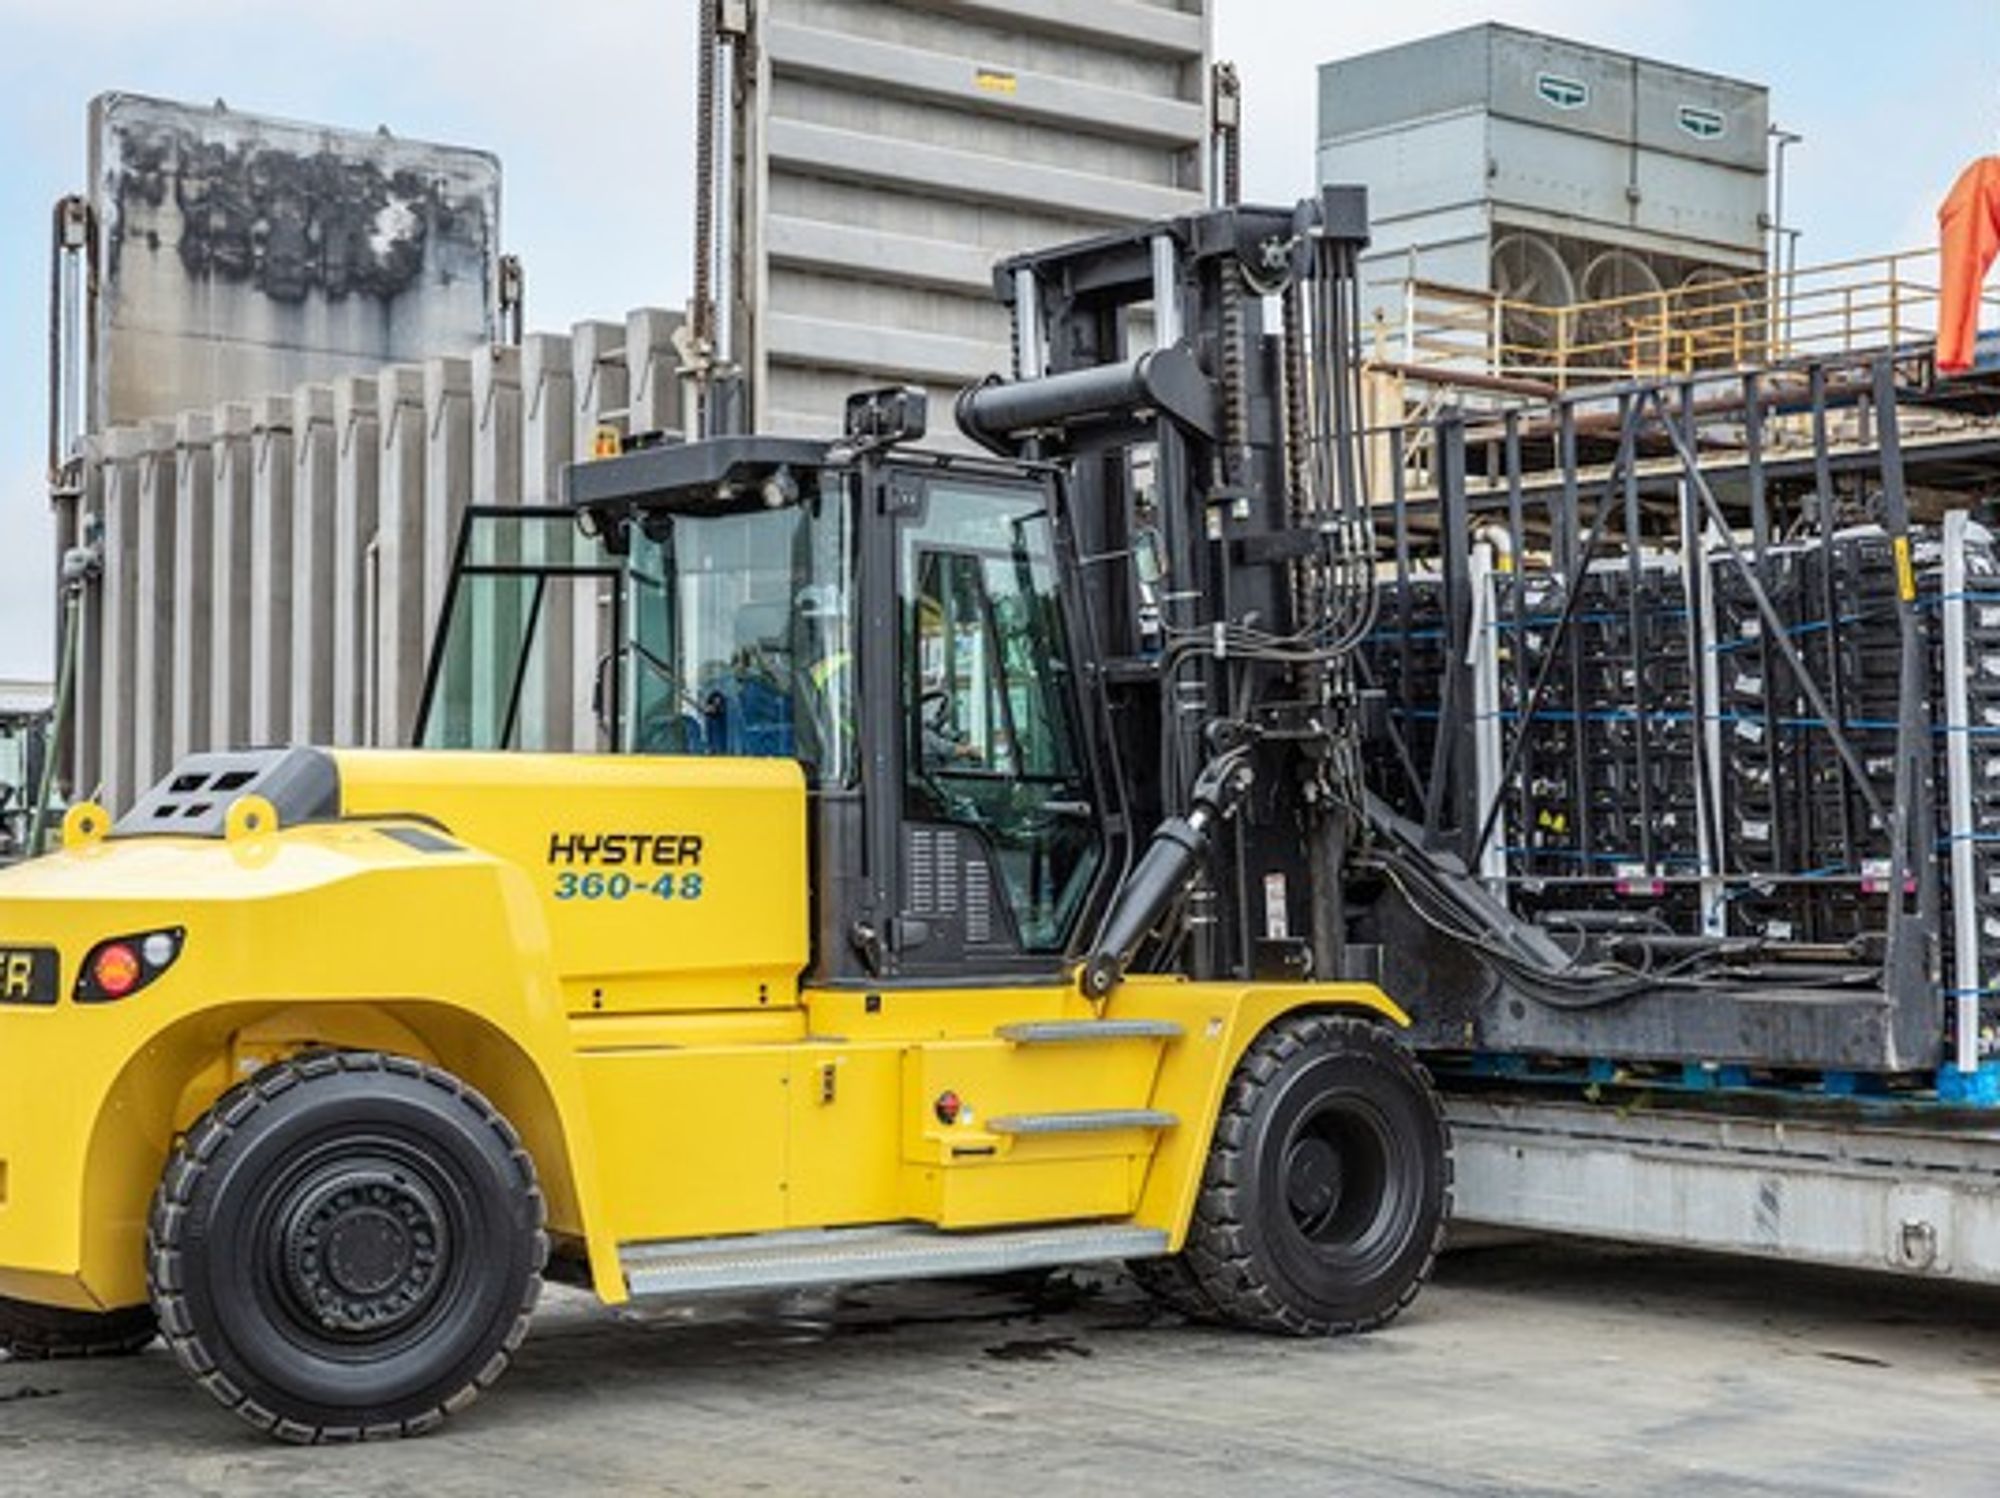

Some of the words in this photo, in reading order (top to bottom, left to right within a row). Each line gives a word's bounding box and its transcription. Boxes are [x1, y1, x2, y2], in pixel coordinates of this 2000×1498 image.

[548, 834, 702, 865] HYSTER
[554, 872, 702, 900] 360-48
[0, 951, 32, 997] R
